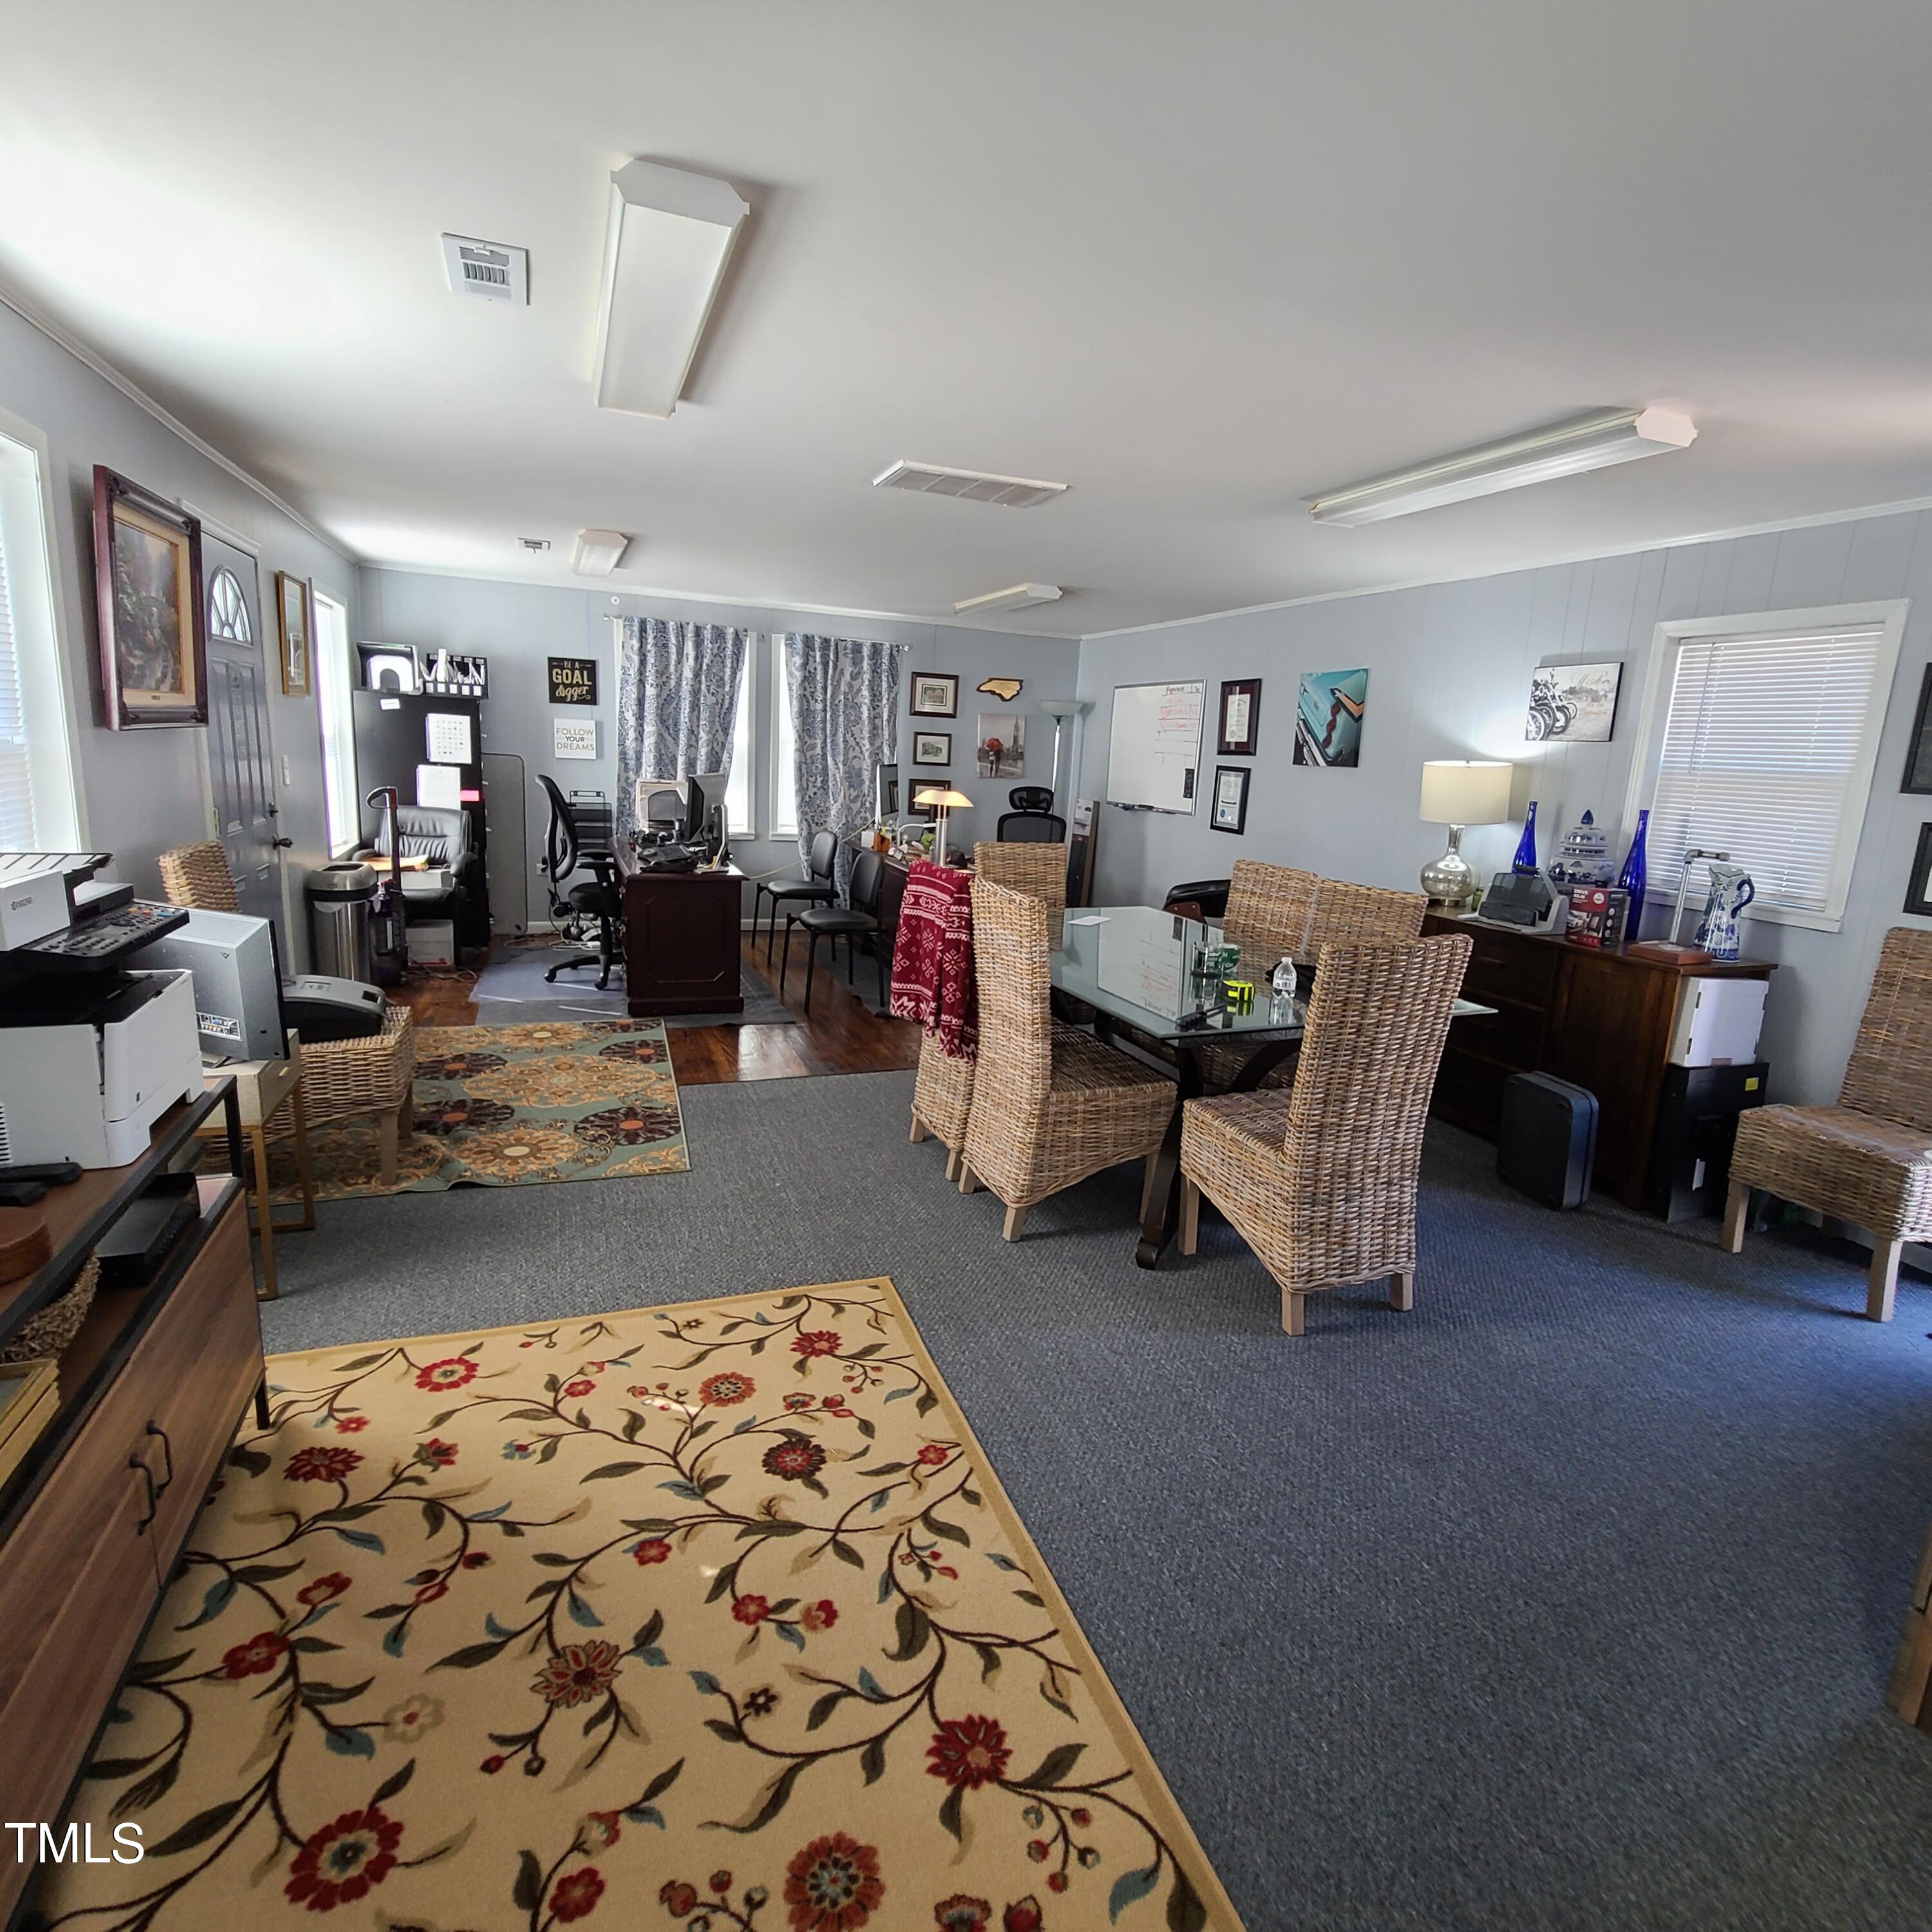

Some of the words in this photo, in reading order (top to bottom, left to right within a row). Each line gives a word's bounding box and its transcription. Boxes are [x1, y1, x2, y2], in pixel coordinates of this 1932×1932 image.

[574, 661, 580, 669] A
[553, 668, 592, 685] GOAL
[556, 685, 589, 701] digger
[556, 727, 594, 737] FOLLOW
[556, 743, 594, 751] DREAMS
